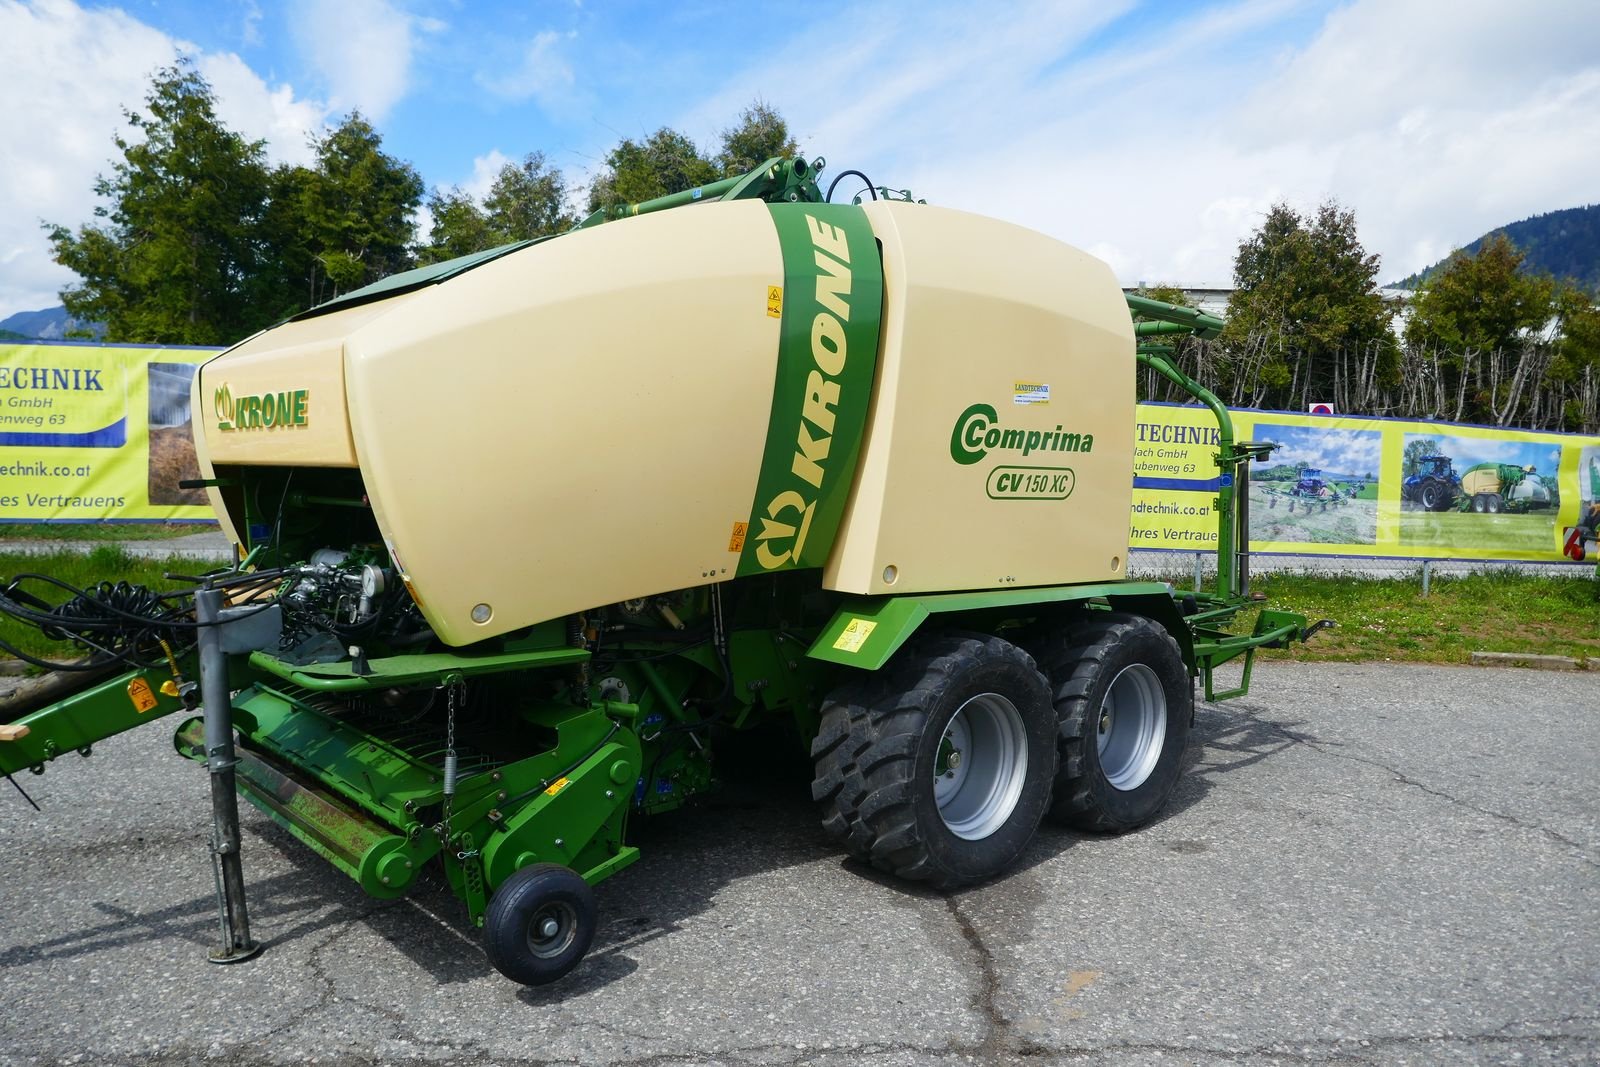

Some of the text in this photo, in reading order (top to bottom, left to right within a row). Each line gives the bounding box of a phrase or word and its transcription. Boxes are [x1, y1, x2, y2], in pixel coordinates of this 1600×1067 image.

[791, 213, 852, 489] KRONE
[7, 396, 53, 408] GmbH
[235, 389, 309, 429] KRONE
[48, 414, 66, 425] 63
[1136, 423, 1221, 446] TECHNIK
[1156, 448, 1188, 459] GmbH
[0, 460, 91, 477] echnik.co.at
[1134, 461, 1196, 475] ubenweg 63
[996, 473, 1069, 493] CV 150 XC
[26, 493, 126, 508] Vertrauens
[1129, 526, 1158, 539] hres
